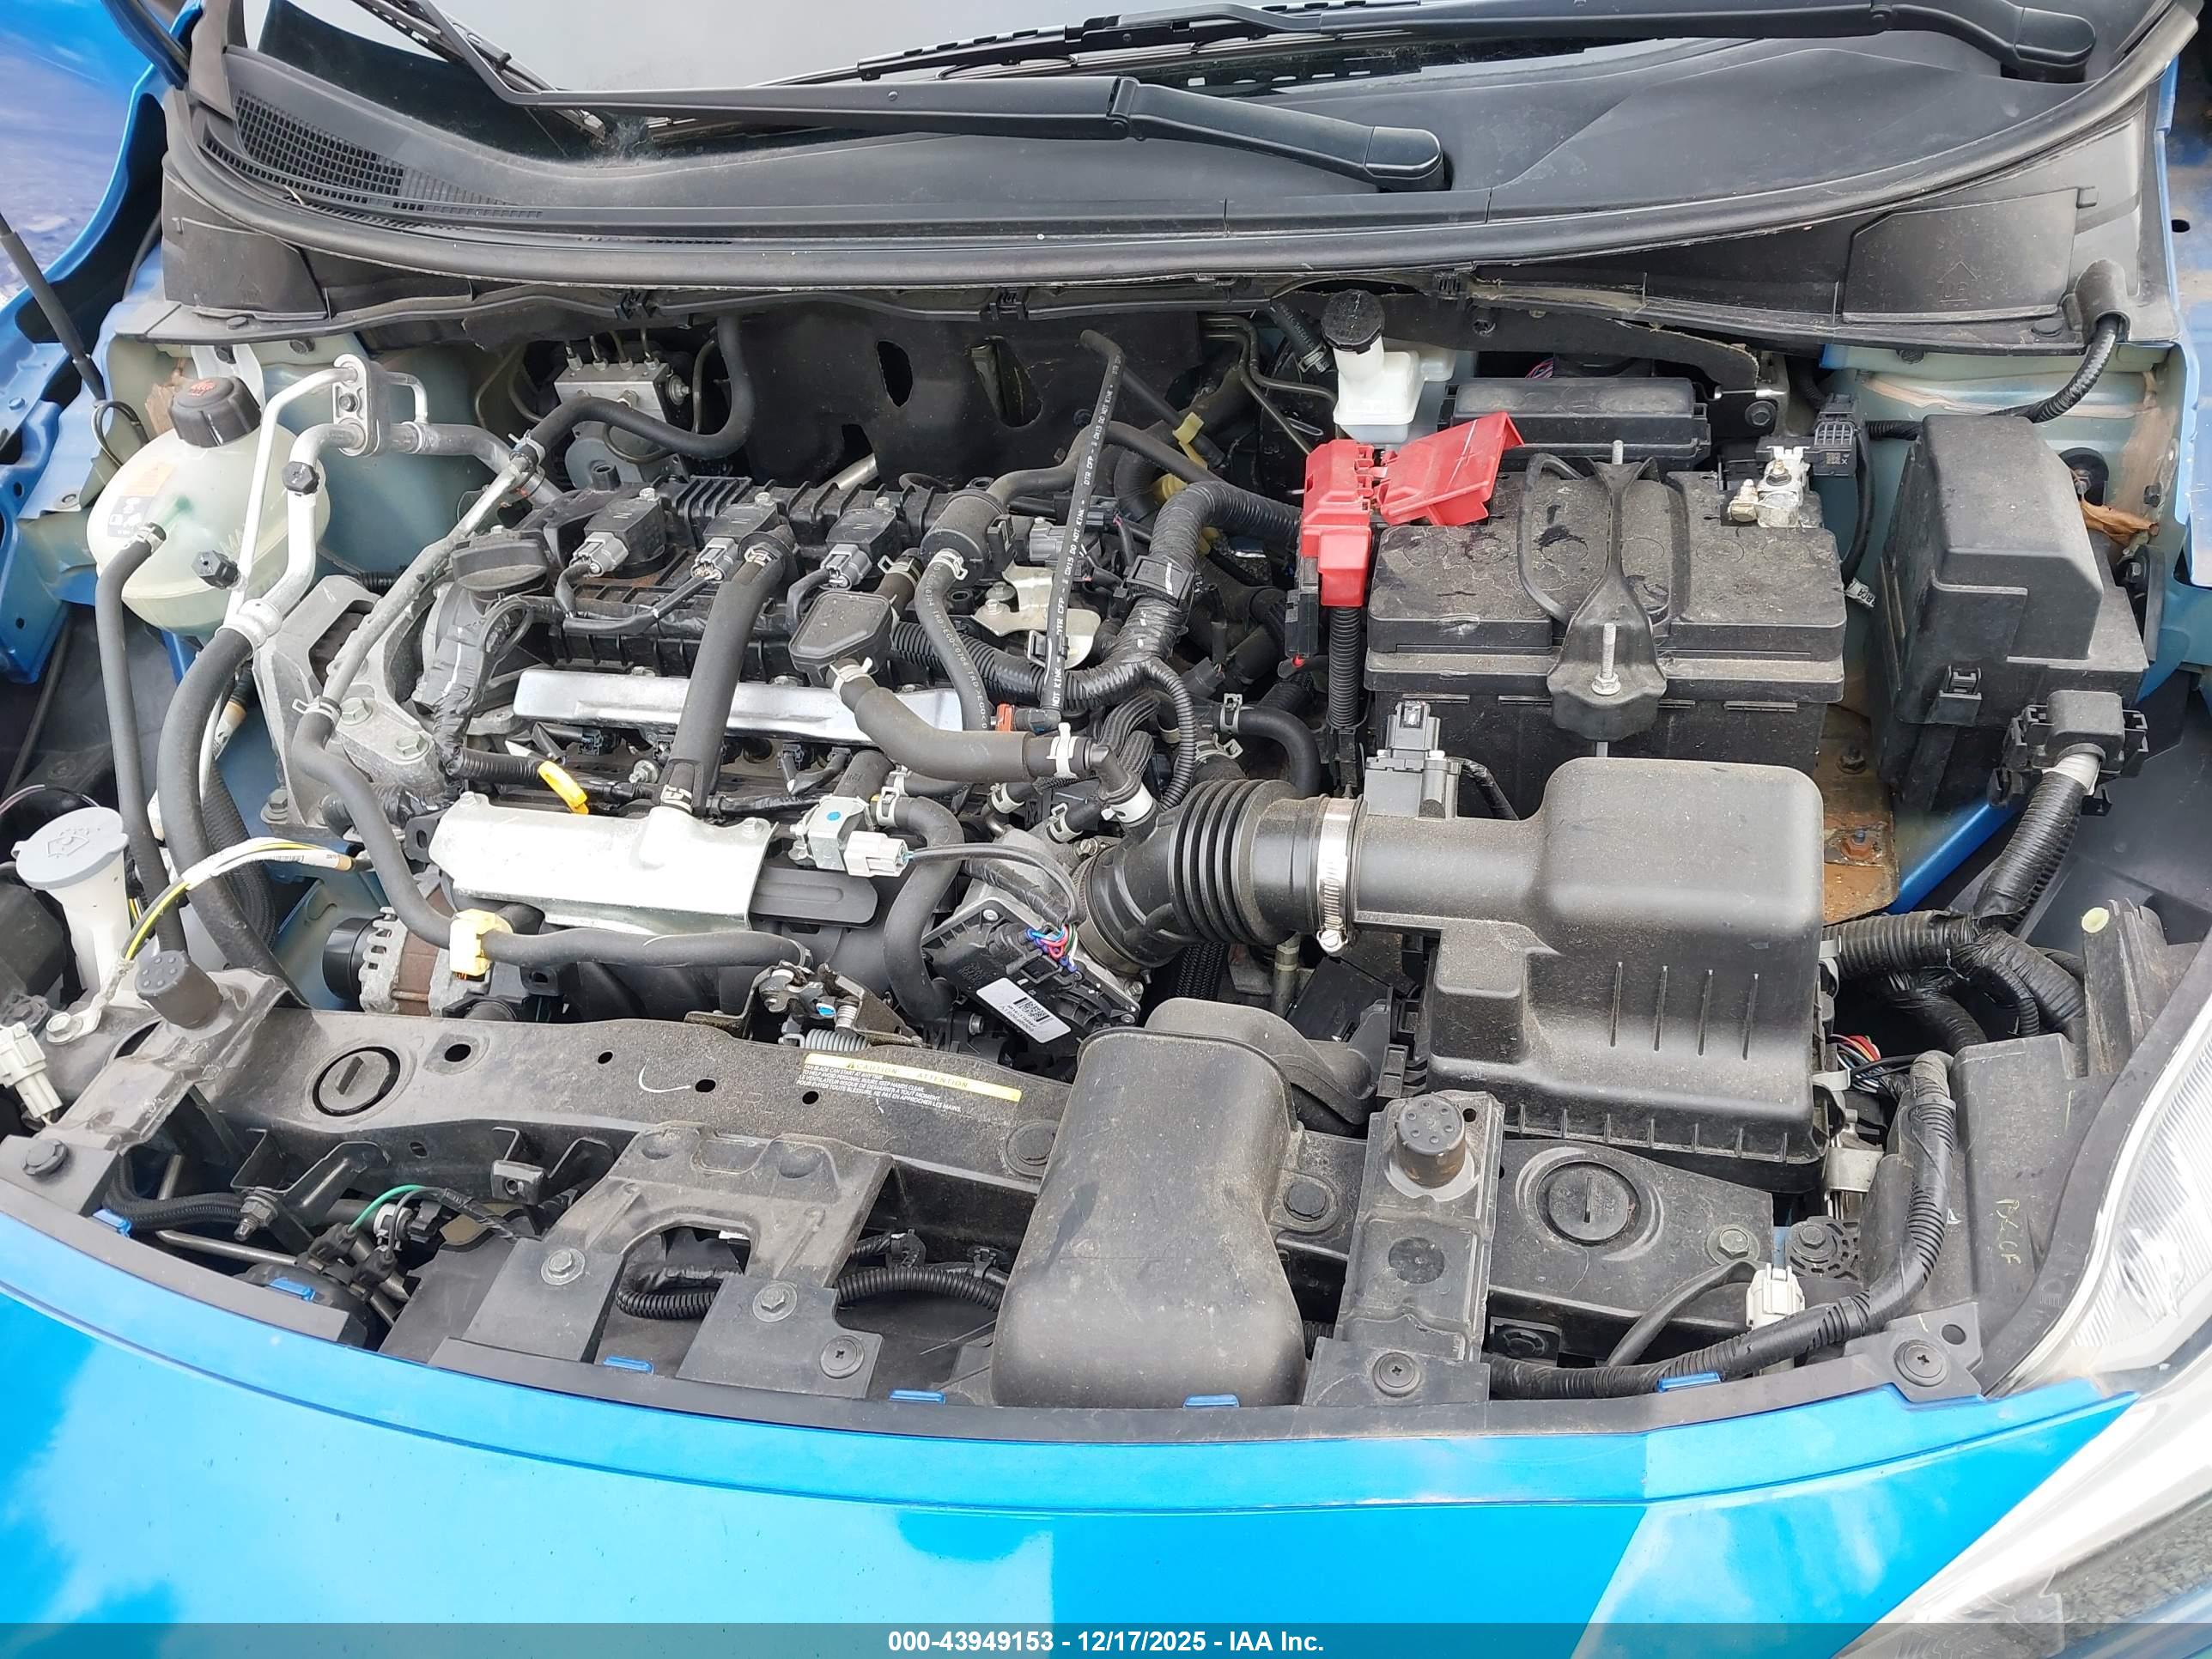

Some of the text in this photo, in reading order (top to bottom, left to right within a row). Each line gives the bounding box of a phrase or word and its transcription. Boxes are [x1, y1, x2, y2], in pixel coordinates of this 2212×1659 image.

[1076, 507, 1085, 526] KINK
[1072, 527, 1081, 543] NOT
[1068, 543, 1078, 555] DO
[1053, 666, 1062, 689] KINK
[1051, 691, 1060, 707] NOT
[805, 1075, 839, 1085] VENTILATEUR
[836, 1073, 861, 1083] PERSONAL
[855, 1063, 969, 1088] CAUTION ATTENTION
[899, 1094, 933, 1105] APPROCHER
[932, 1099, 943, 1108] LES
